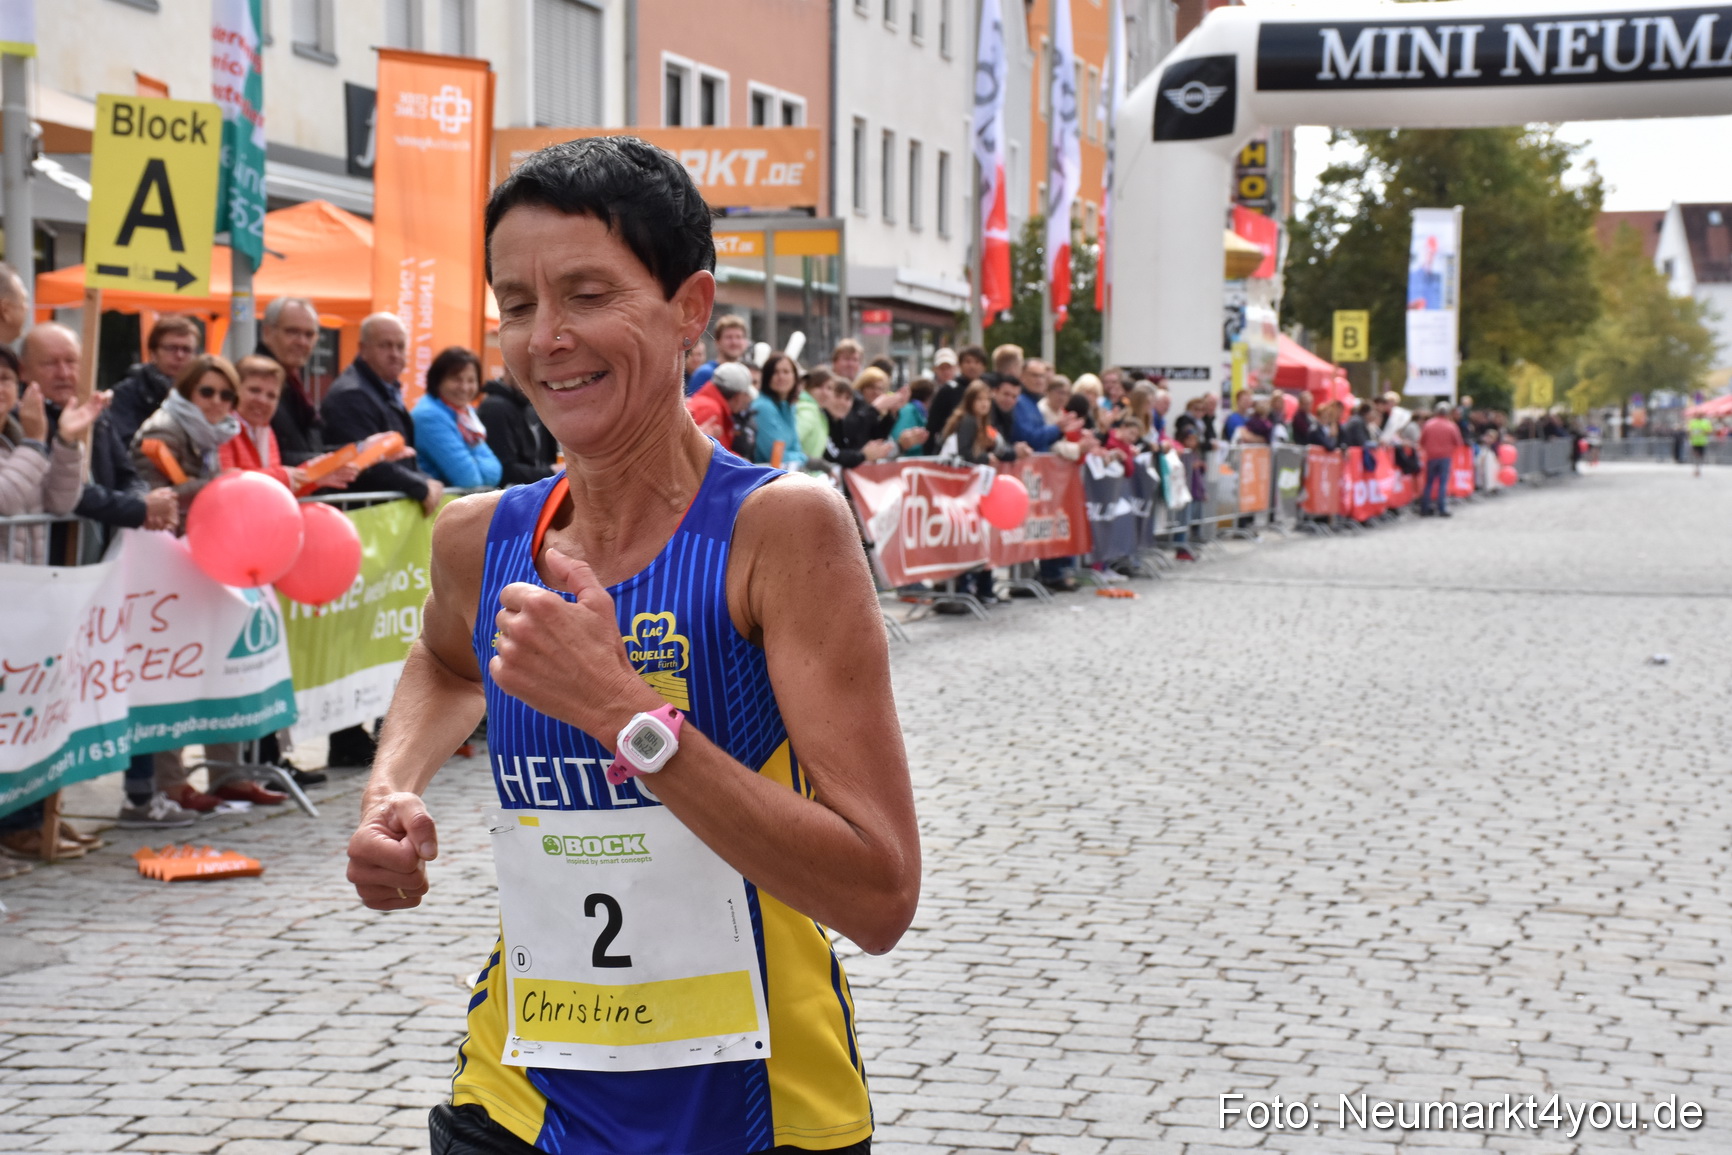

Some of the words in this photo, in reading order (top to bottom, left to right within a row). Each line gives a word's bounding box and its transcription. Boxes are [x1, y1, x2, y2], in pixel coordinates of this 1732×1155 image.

[1317, 24, 1485, 80] MINI
[1500, 13, 1732, 76] NEUM
[111, 102, 208, 145] Block
[115, 157, 186, 252] A
[1342, 326, 1359, 349] B
[641, 626, 664, 638] LAC
[629, 648, 676, 662] QUELLE
[657, 660, 678, 669] Fürth
[562, 832, 650, 858] BOCK
[565, 856, 590, 866] inspired
[590, 856, 599, 866] by
[600, 857, 620, 865] smart
[620, 855, 653, 864] concepts
[584, 893, 632, 968] 2
[517, 952, 526, 966] D
[522, 990, 653, 1024] Christine
